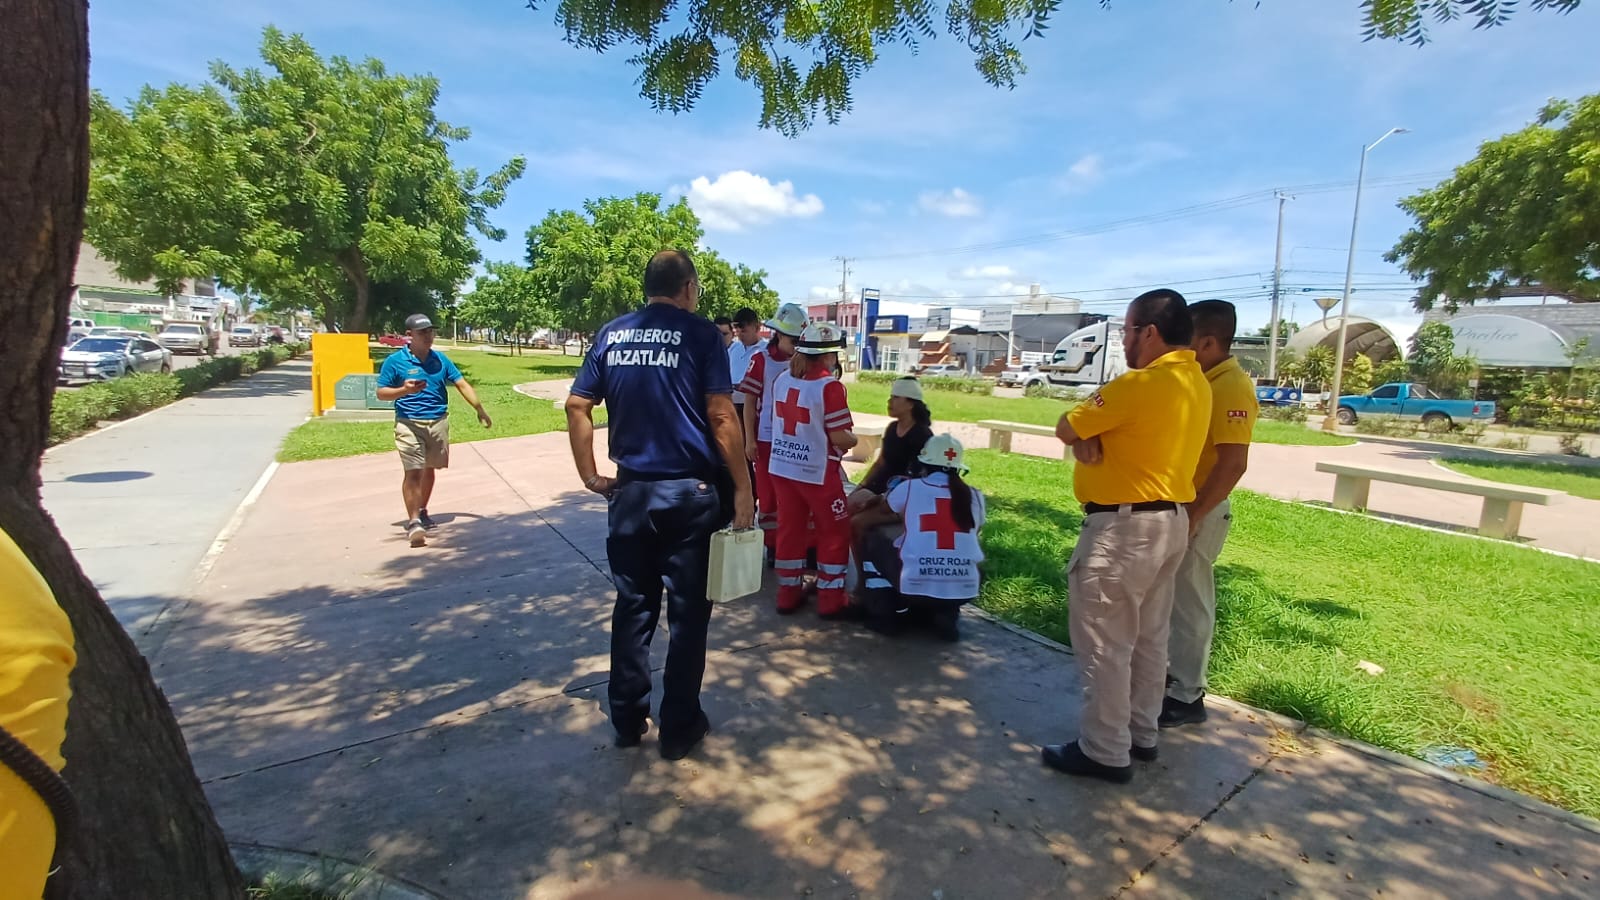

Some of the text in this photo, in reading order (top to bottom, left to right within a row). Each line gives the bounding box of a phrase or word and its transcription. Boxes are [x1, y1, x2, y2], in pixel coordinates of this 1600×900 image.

[607, 328, 682, 345] BOMBEROS
[607, 347, 679, 368] MAZATLÁN
[788, 442, 810, 453] ROJA
[919, 557, 945, 565] CRUZ
[919, 568, 969, 576] MEXICANA
